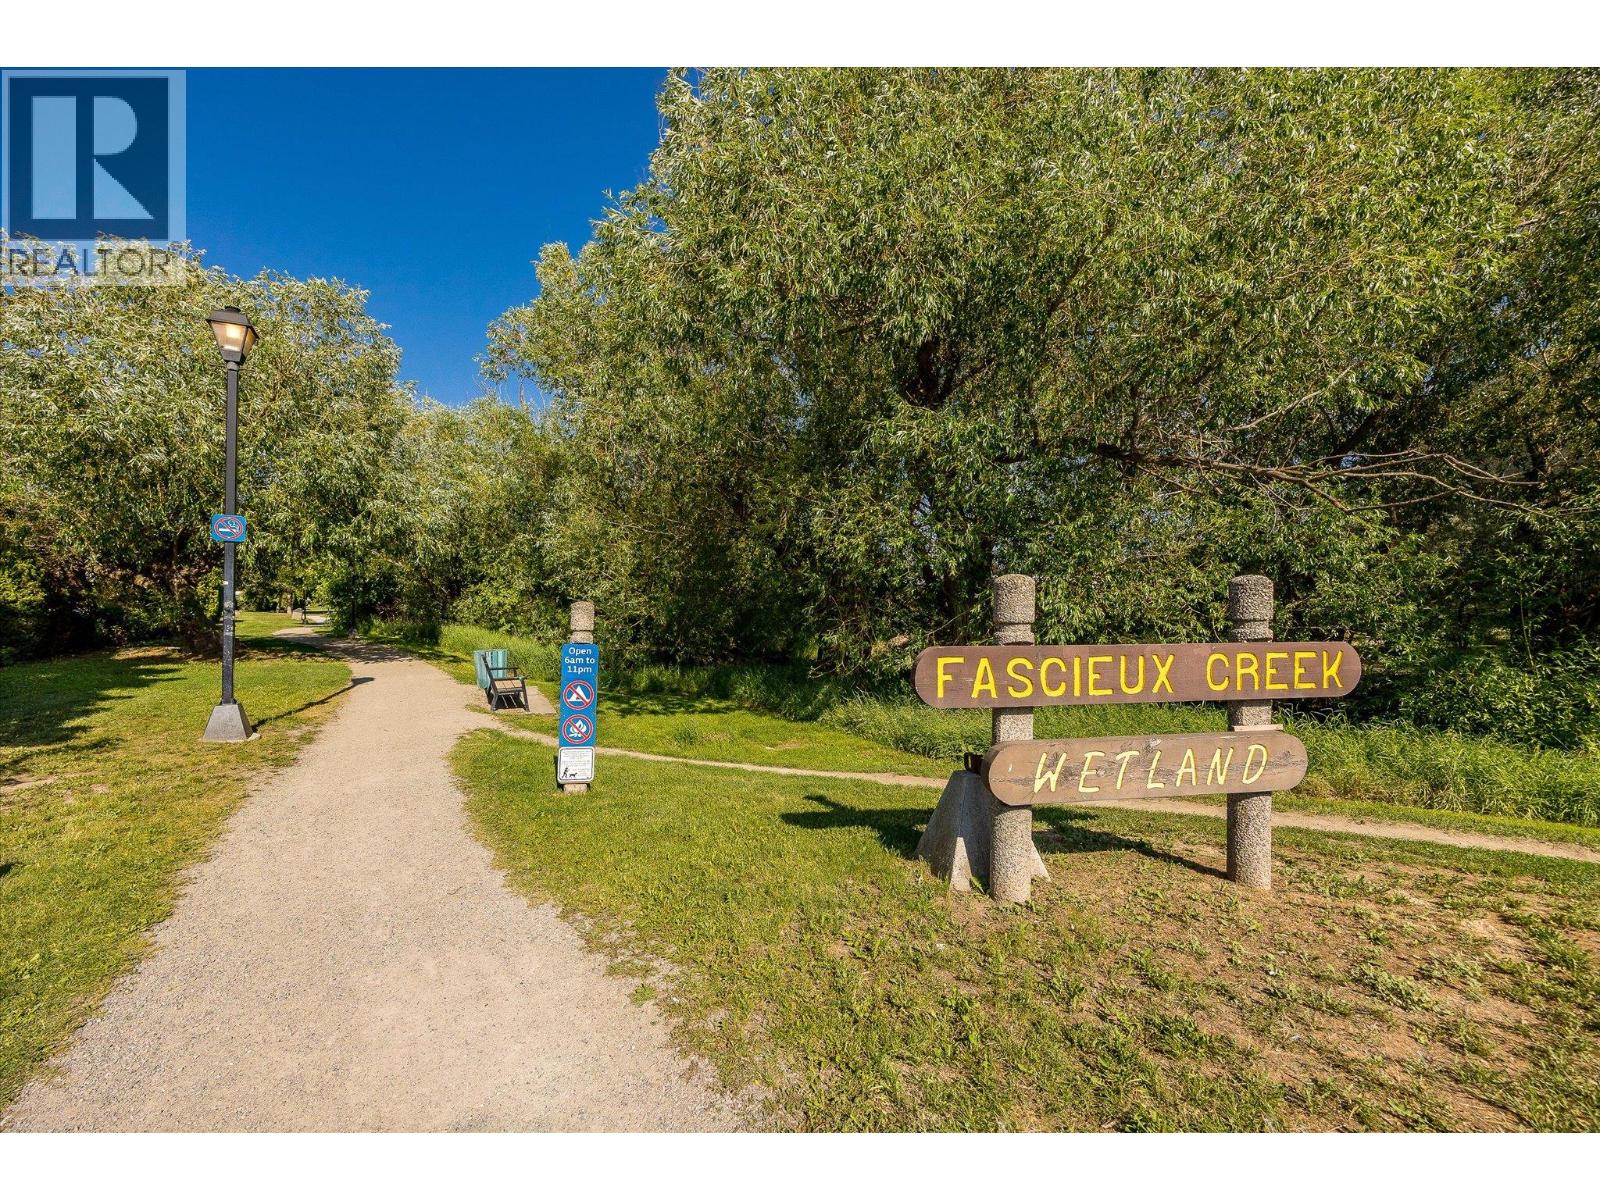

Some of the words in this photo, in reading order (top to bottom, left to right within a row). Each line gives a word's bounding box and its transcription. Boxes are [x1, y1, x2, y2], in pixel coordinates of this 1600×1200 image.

[568, 647, 592, 656] Open
[564, 656, 584, 664] 6am
[586, 656, 595, 664] to
[567, 666, 592, 675] 11pm
[935, 653, 1175, 700] FASCIEUX
[1205, 649, 1345, 692] CREEK
[1033, 744, 1269, 794] WETLAND
